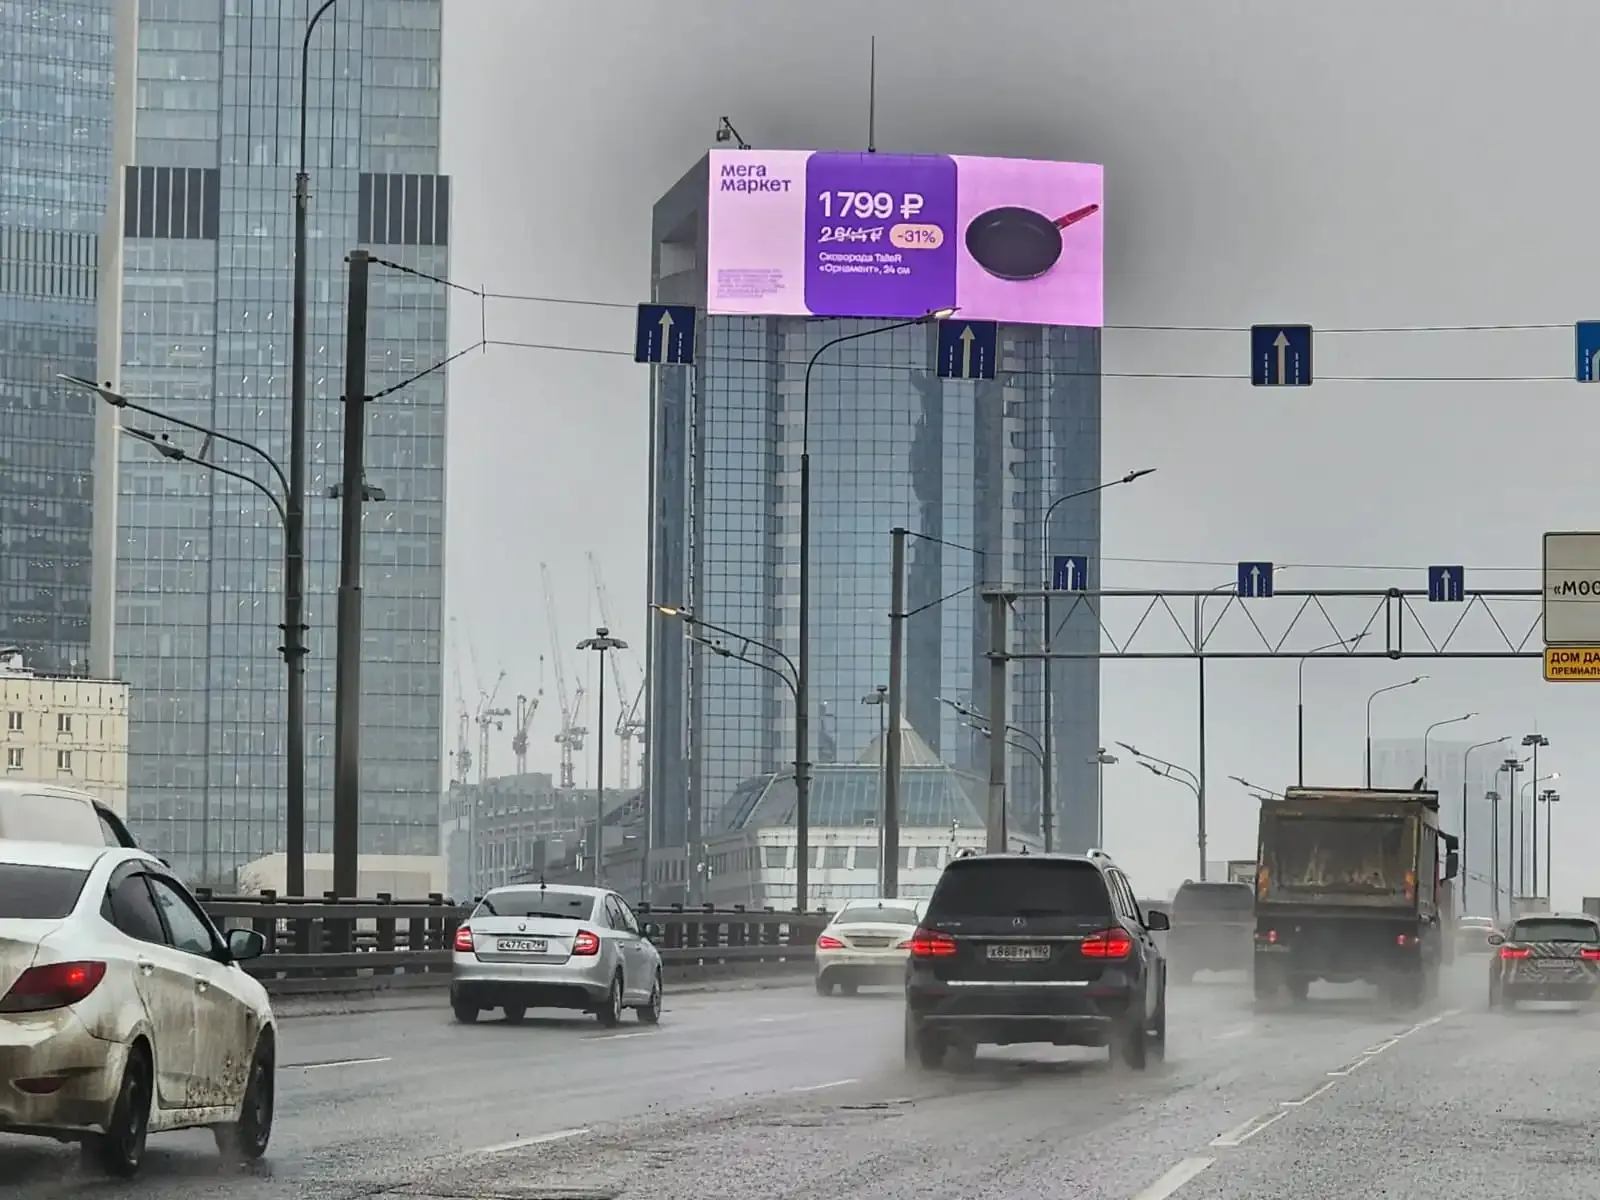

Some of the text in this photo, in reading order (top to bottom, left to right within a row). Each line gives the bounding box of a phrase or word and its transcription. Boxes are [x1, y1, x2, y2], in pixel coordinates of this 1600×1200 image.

[720, 164, 767, 177] мега
[720, 178, 792, 194] маркет
[900, 193, 924, 220] ₽
[896, 229, 937, 244] -31%
[818, 251, 874, 263] Сковорода
[883, 264, 895, 274] 24
[896, 266, 911, 275] см
[1550, 652, 1580, 665] ДОМ
